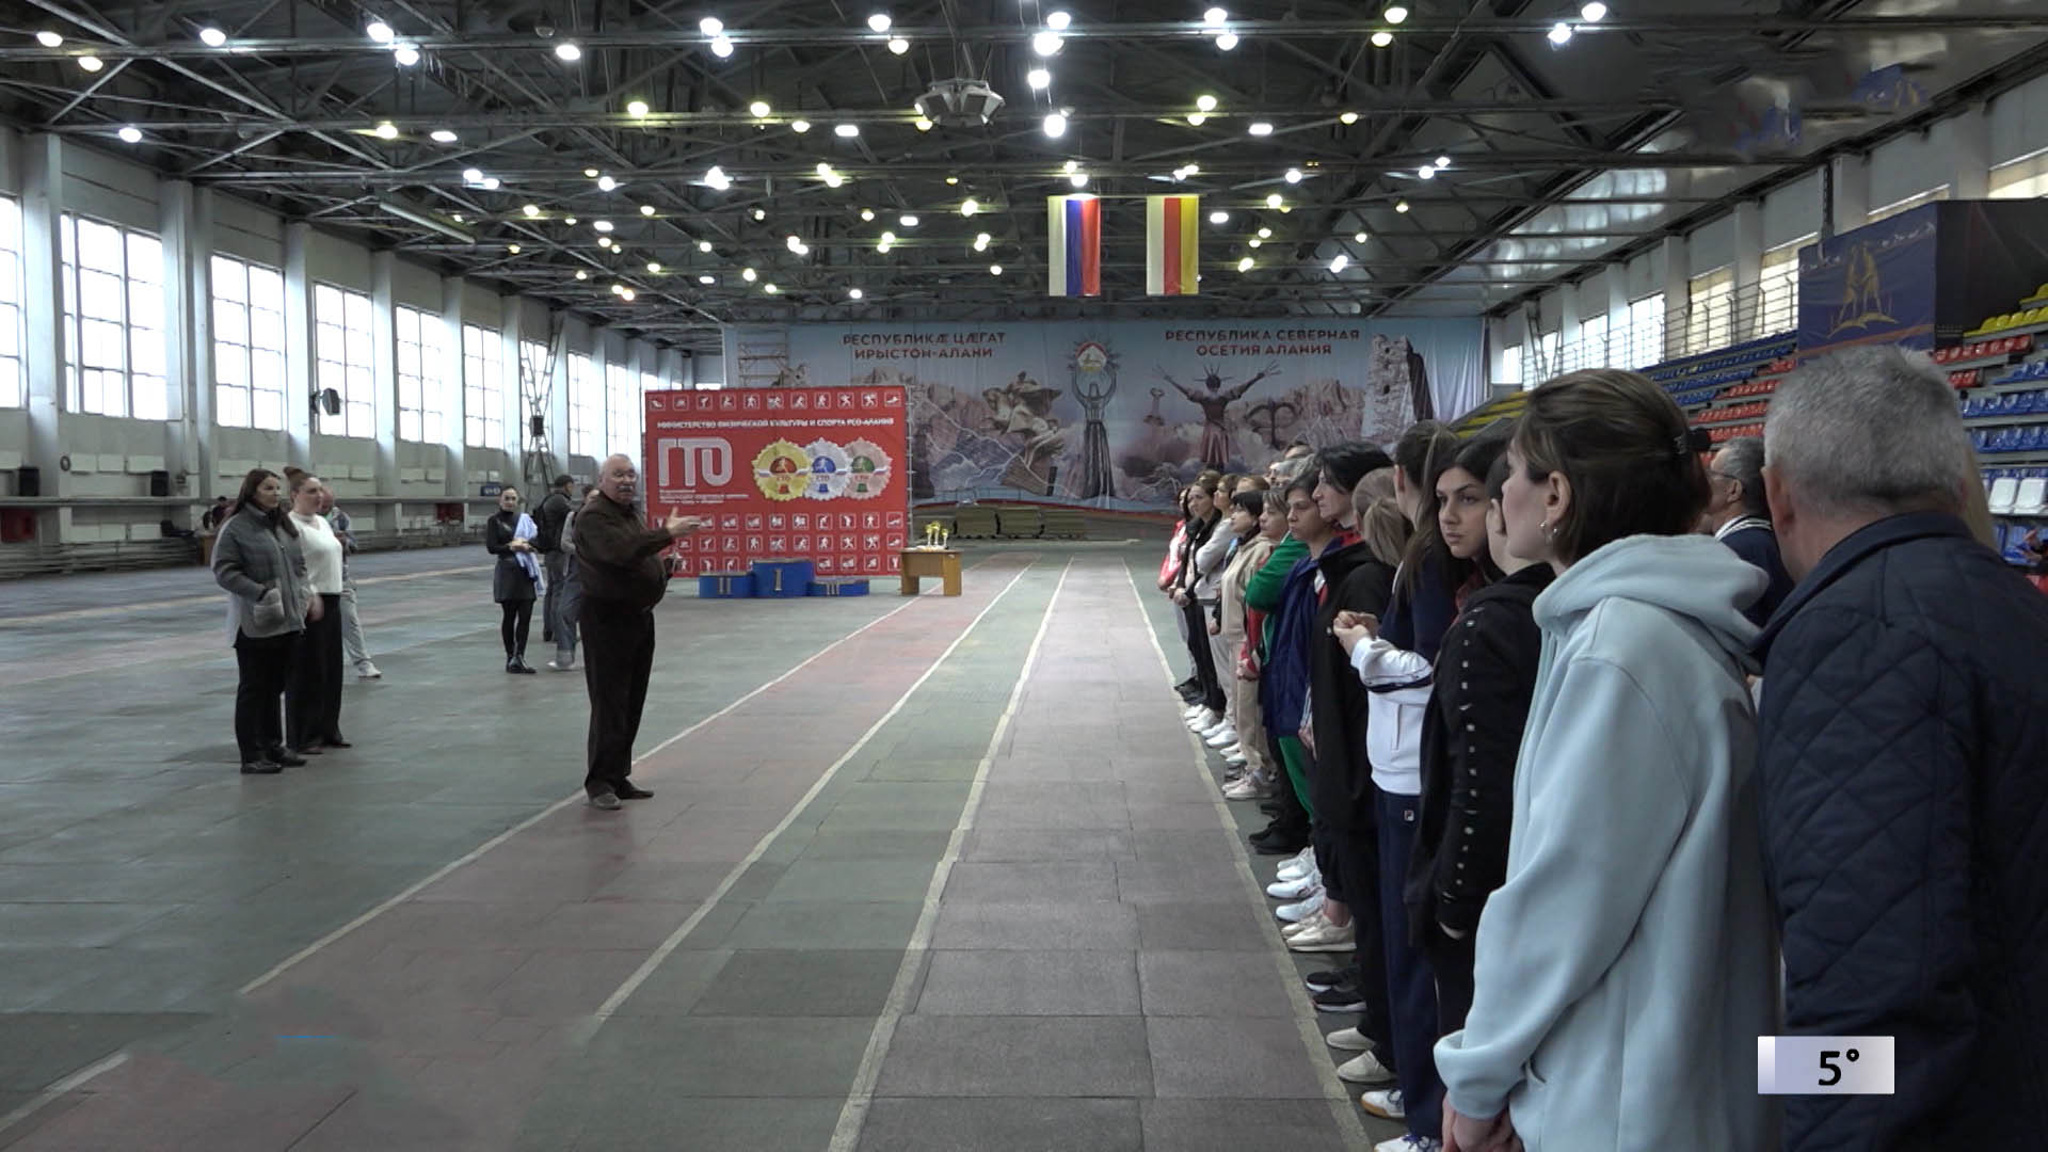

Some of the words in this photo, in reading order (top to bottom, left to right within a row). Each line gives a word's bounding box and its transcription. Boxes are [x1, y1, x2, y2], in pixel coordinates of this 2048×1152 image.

[1165, 329, 1272, 342] РЕСПУБЛИКА
[1276, 329, 1361, 341] СЕВЕРНАЯ
[854, 347, 993, 360] ИРЫСТОН-АЛАНИ
[1196, 344, 1261, 357] ОСЕТИЯ
[1265, 344, 1333, 356] АЛАНИЯ
[817, 418, 846, 427] СПОРТА
[657, 437, 734, 487] ГТО
